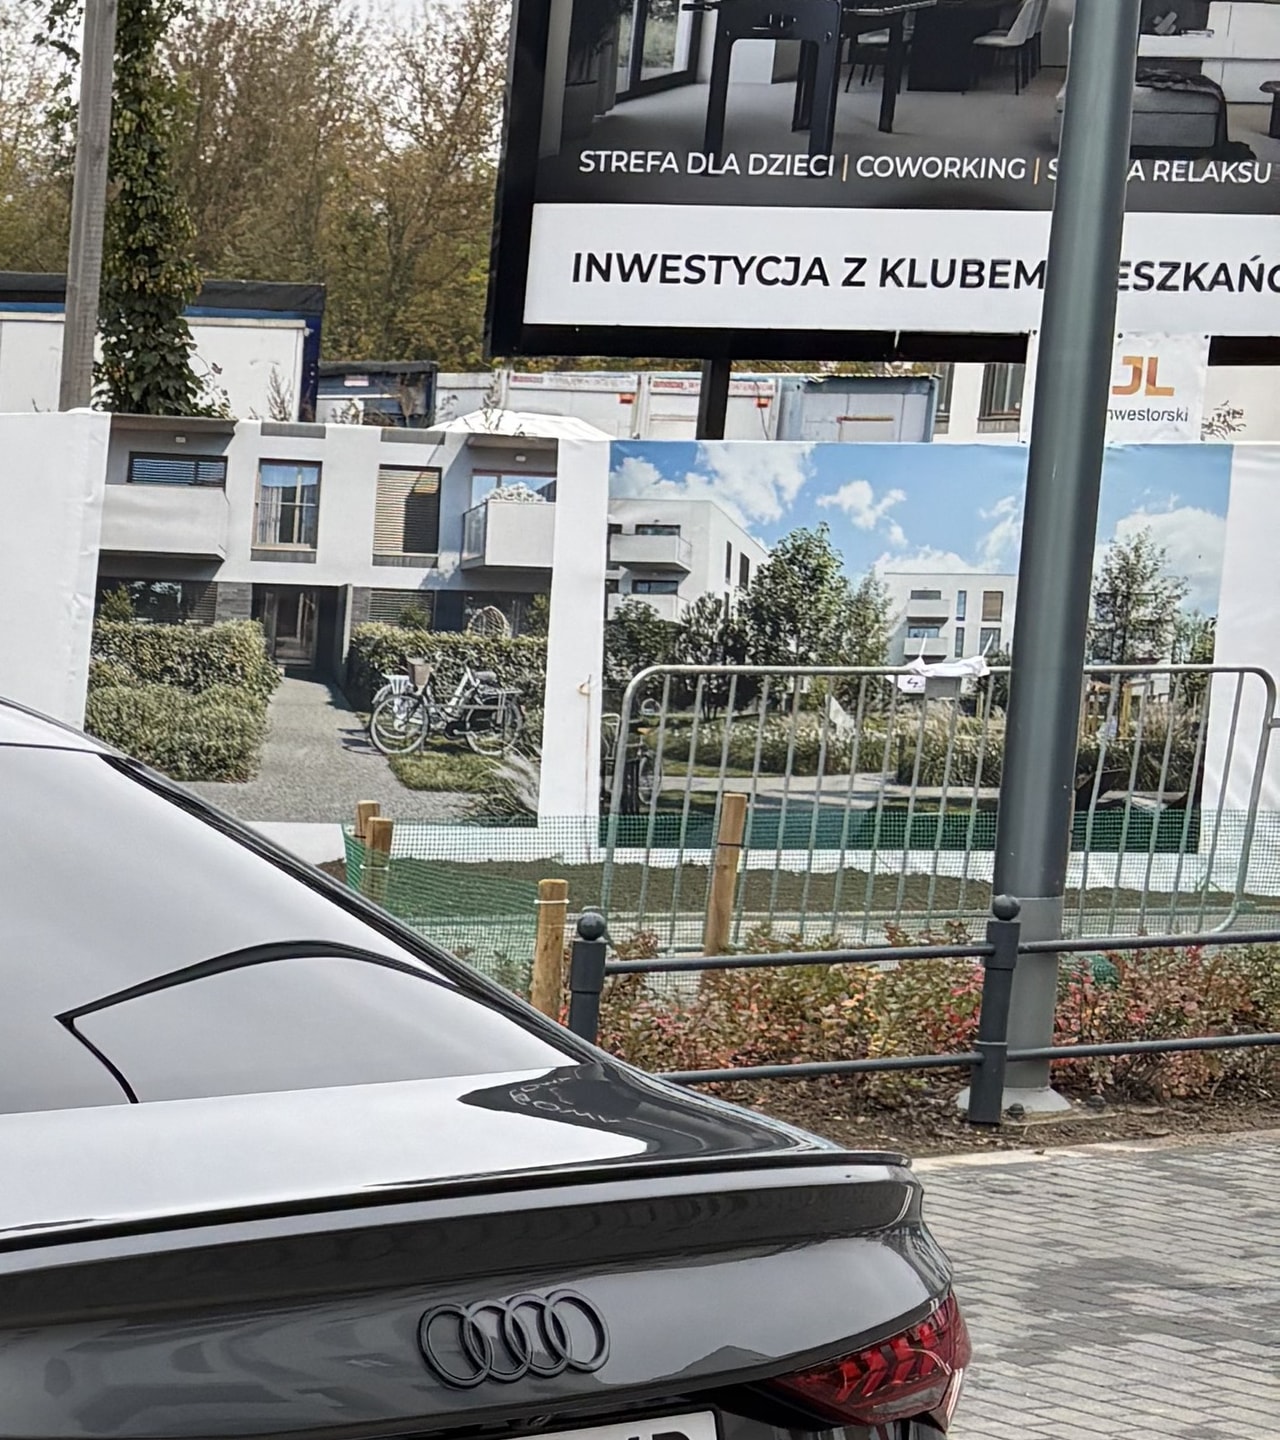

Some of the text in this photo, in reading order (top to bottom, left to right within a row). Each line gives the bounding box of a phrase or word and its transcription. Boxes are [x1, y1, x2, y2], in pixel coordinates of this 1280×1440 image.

[578, 150, 680, 174] STREFA
[686, 152, 741, 176] DLA
[747, 153, 835, 178] DZIECI
[856, 155, 1026, 180] COWORKING
[1152, 160, 1272, 184] RELAKSU
[571, 252, 831, 286] INWESTYCJA
[841, 257, 867, 287] Z
[879, 257, 1047, 290] KLUBEM
